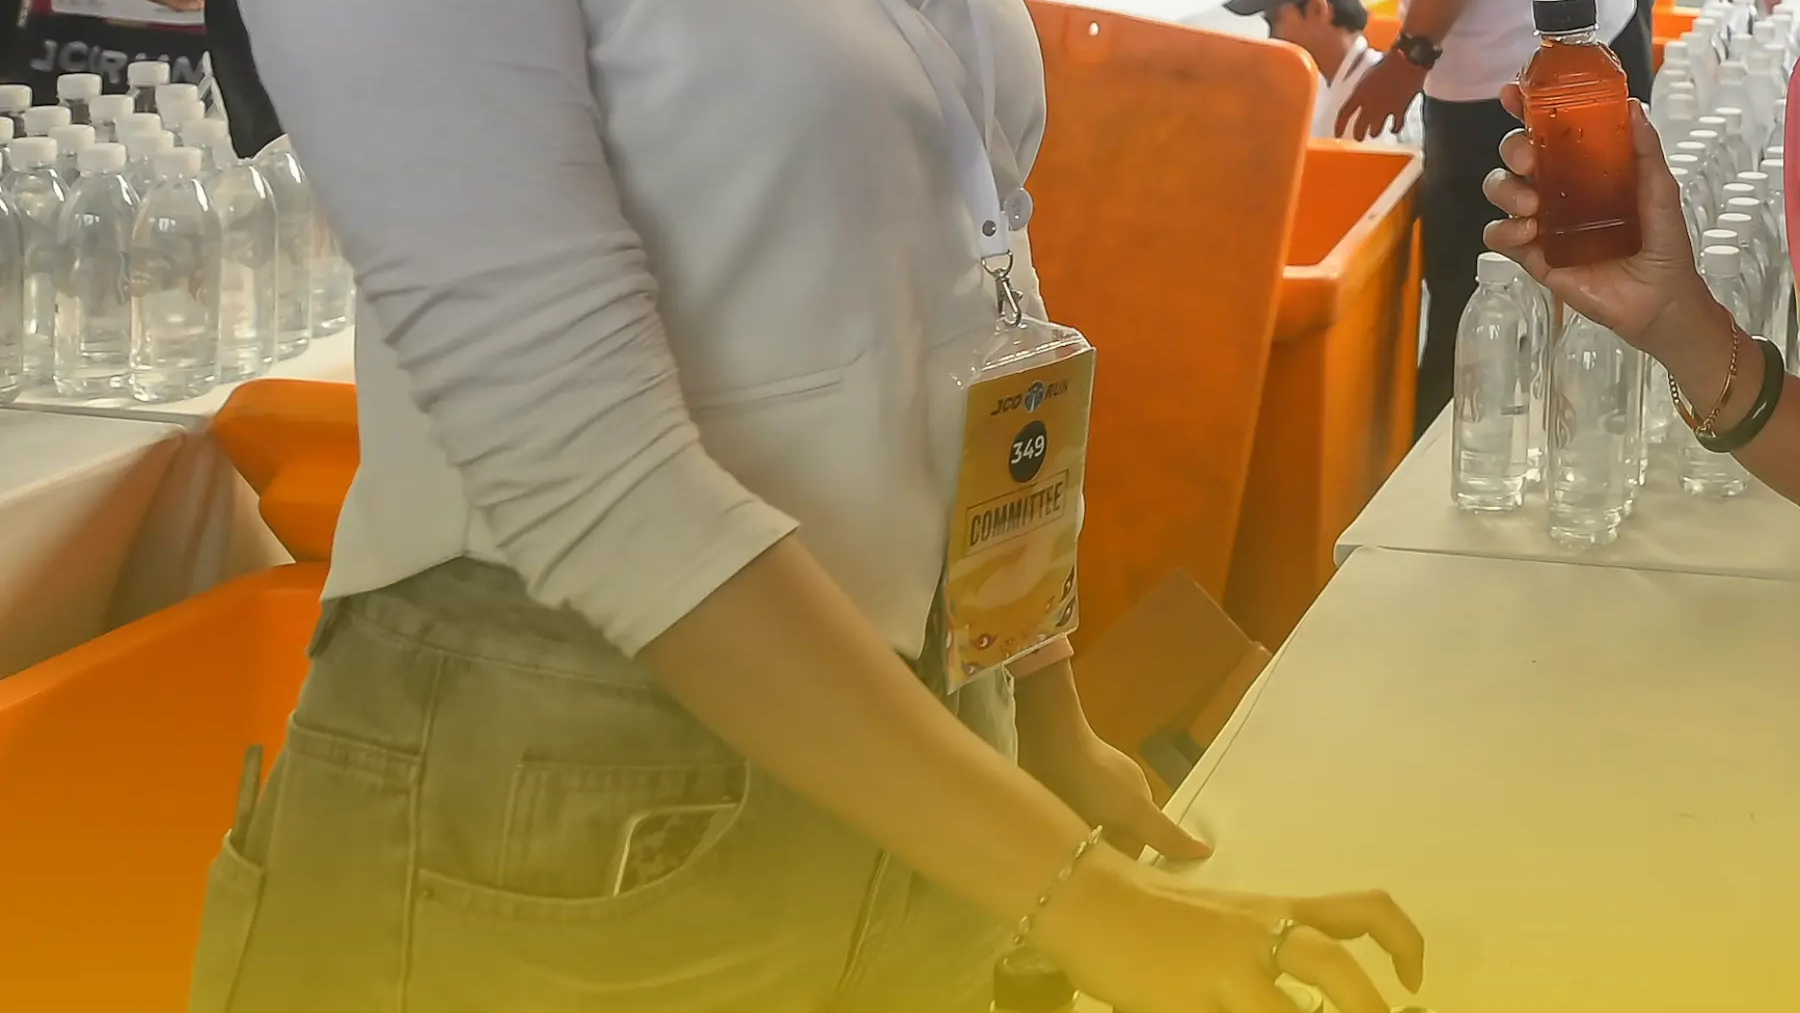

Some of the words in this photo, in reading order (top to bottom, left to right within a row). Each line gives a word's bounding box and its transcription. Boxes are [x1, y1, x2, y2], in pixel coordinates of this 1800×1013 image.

[990, 394, 1022, 416] JCO
[1011, 435, 1045, 465] 349
[970, 481, 1063, 547] COMMITTEE
